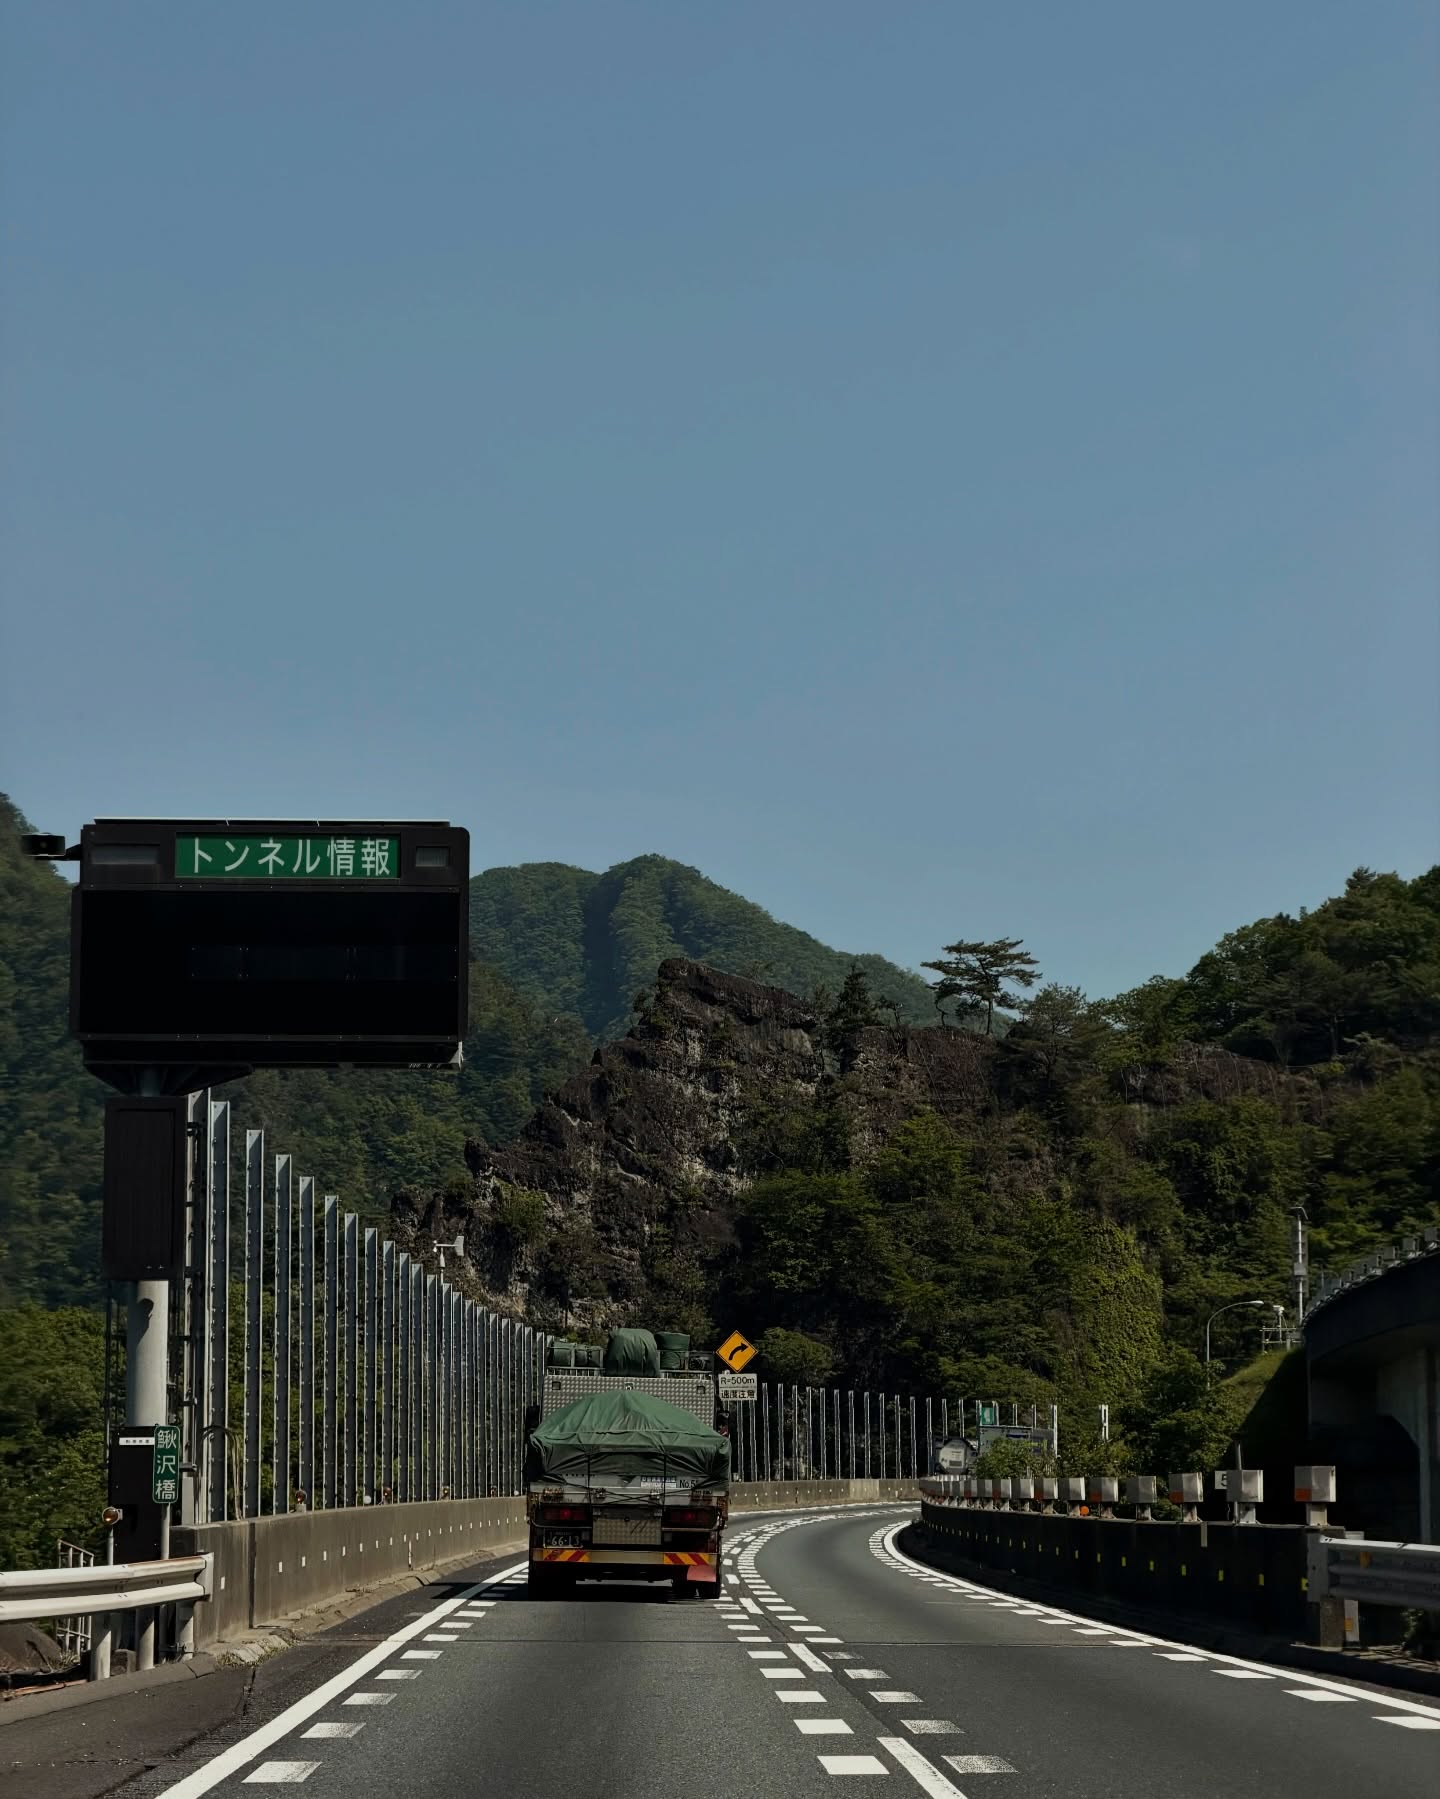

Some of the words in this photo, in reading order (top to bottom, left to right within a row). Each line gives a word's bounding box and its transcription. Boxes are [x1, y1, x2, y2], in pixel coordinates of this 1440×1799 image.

[193, 837, 391, 877] トンネル情報
[720, 1377, 755, 1385] R=500m
[155, 1429, 177, 1500] 鰍沢橋
